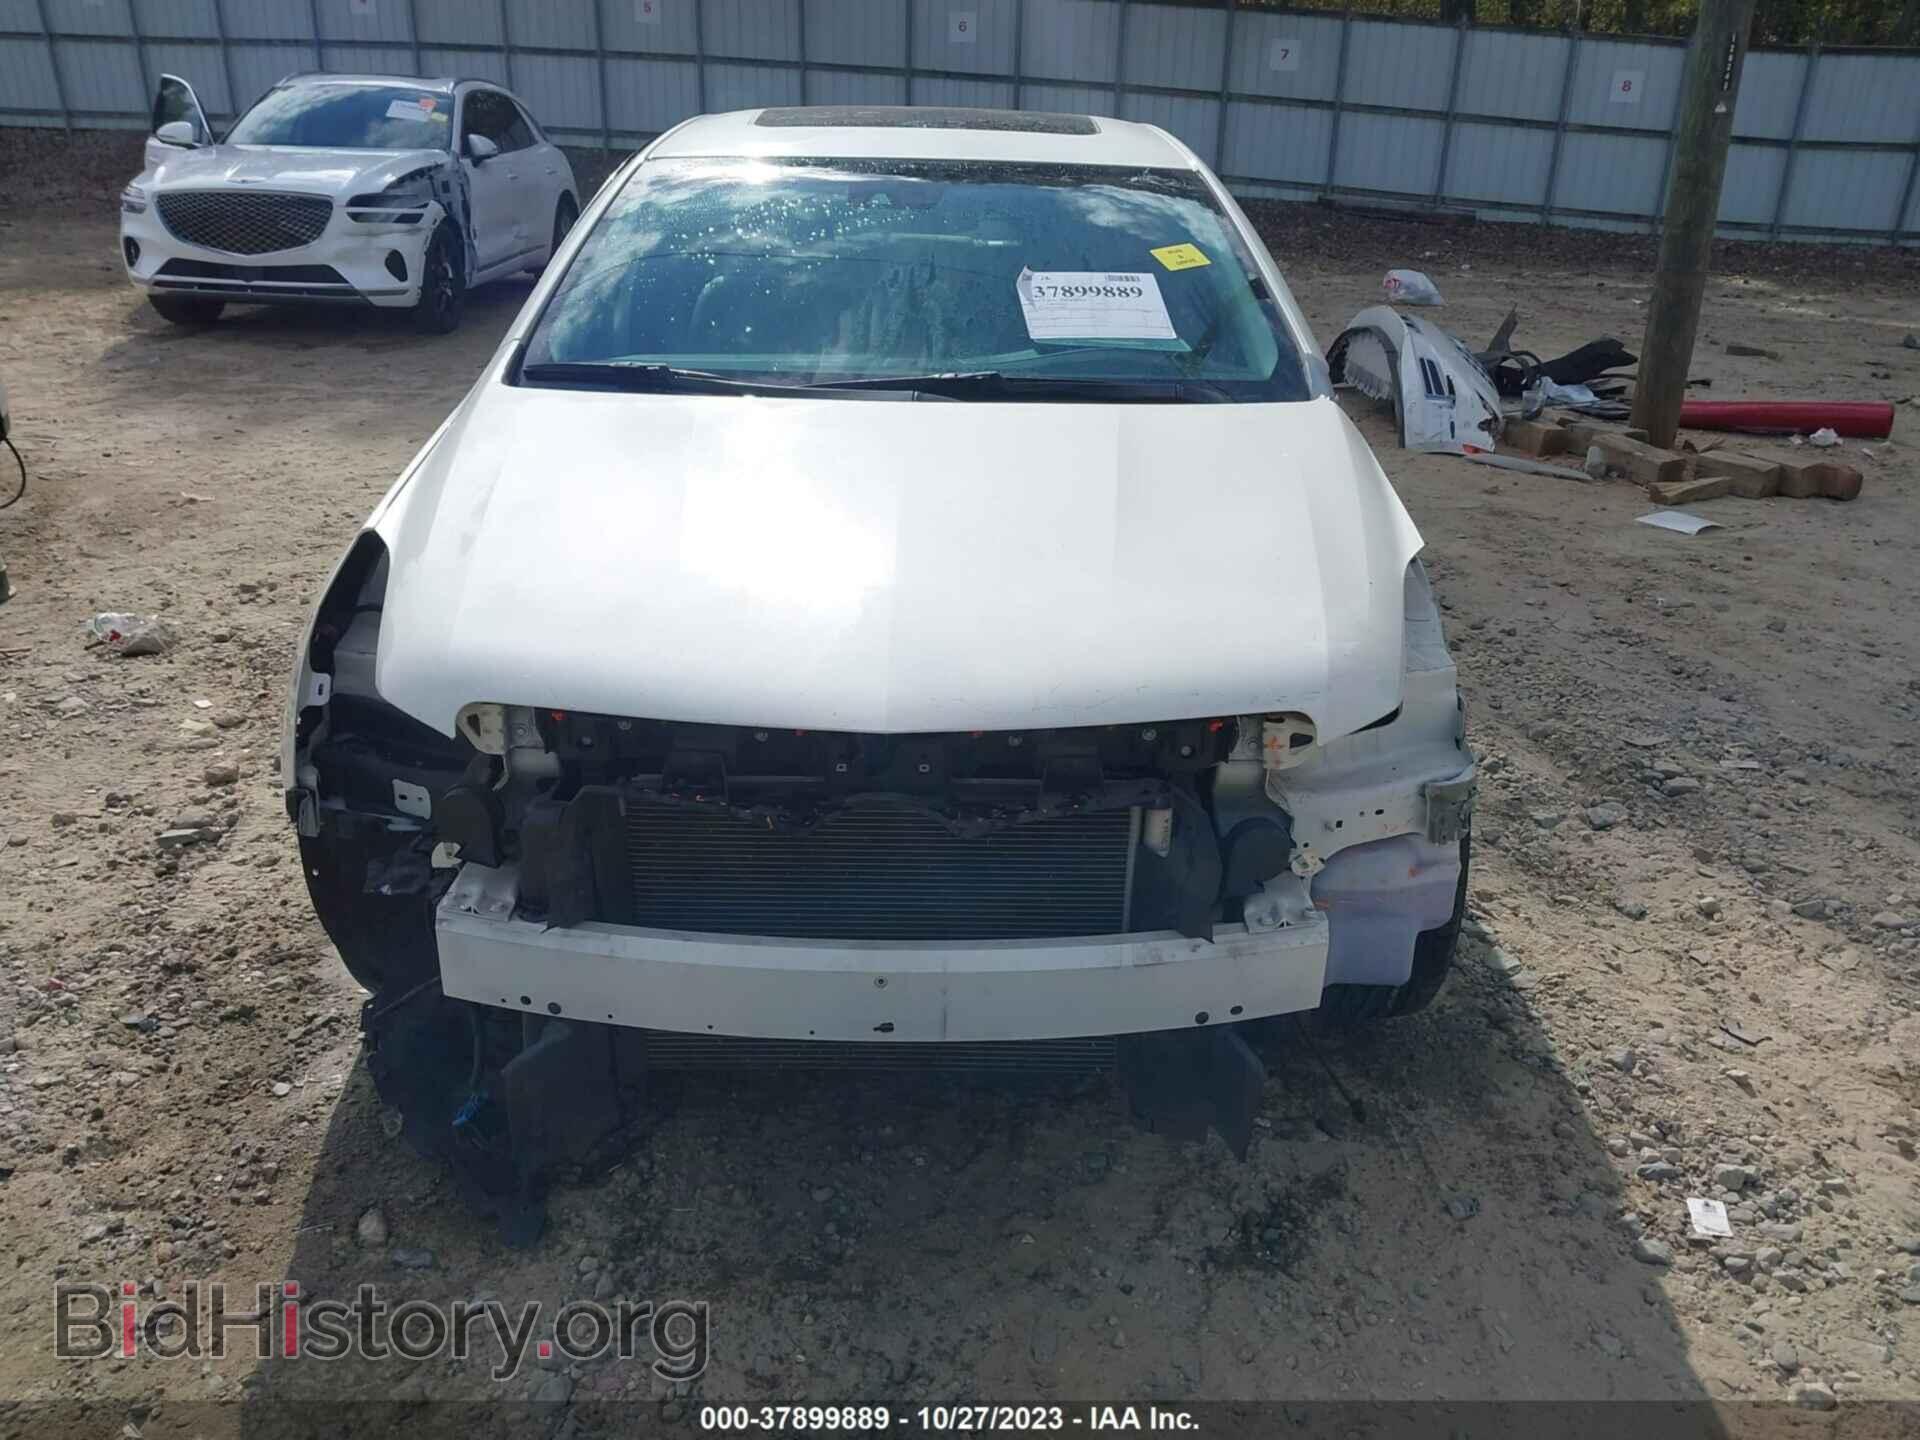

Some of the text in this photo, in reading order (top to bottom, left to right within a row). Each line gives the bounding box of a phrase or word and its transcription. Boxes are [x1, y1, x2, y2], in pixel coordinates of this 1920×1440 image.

[958, 19, 968, 32] 6
[1280, 48, 1289, 61] 7
[1622, 79, 1632, 92] 8
[1034, 285, 1144, 298] 37899889
